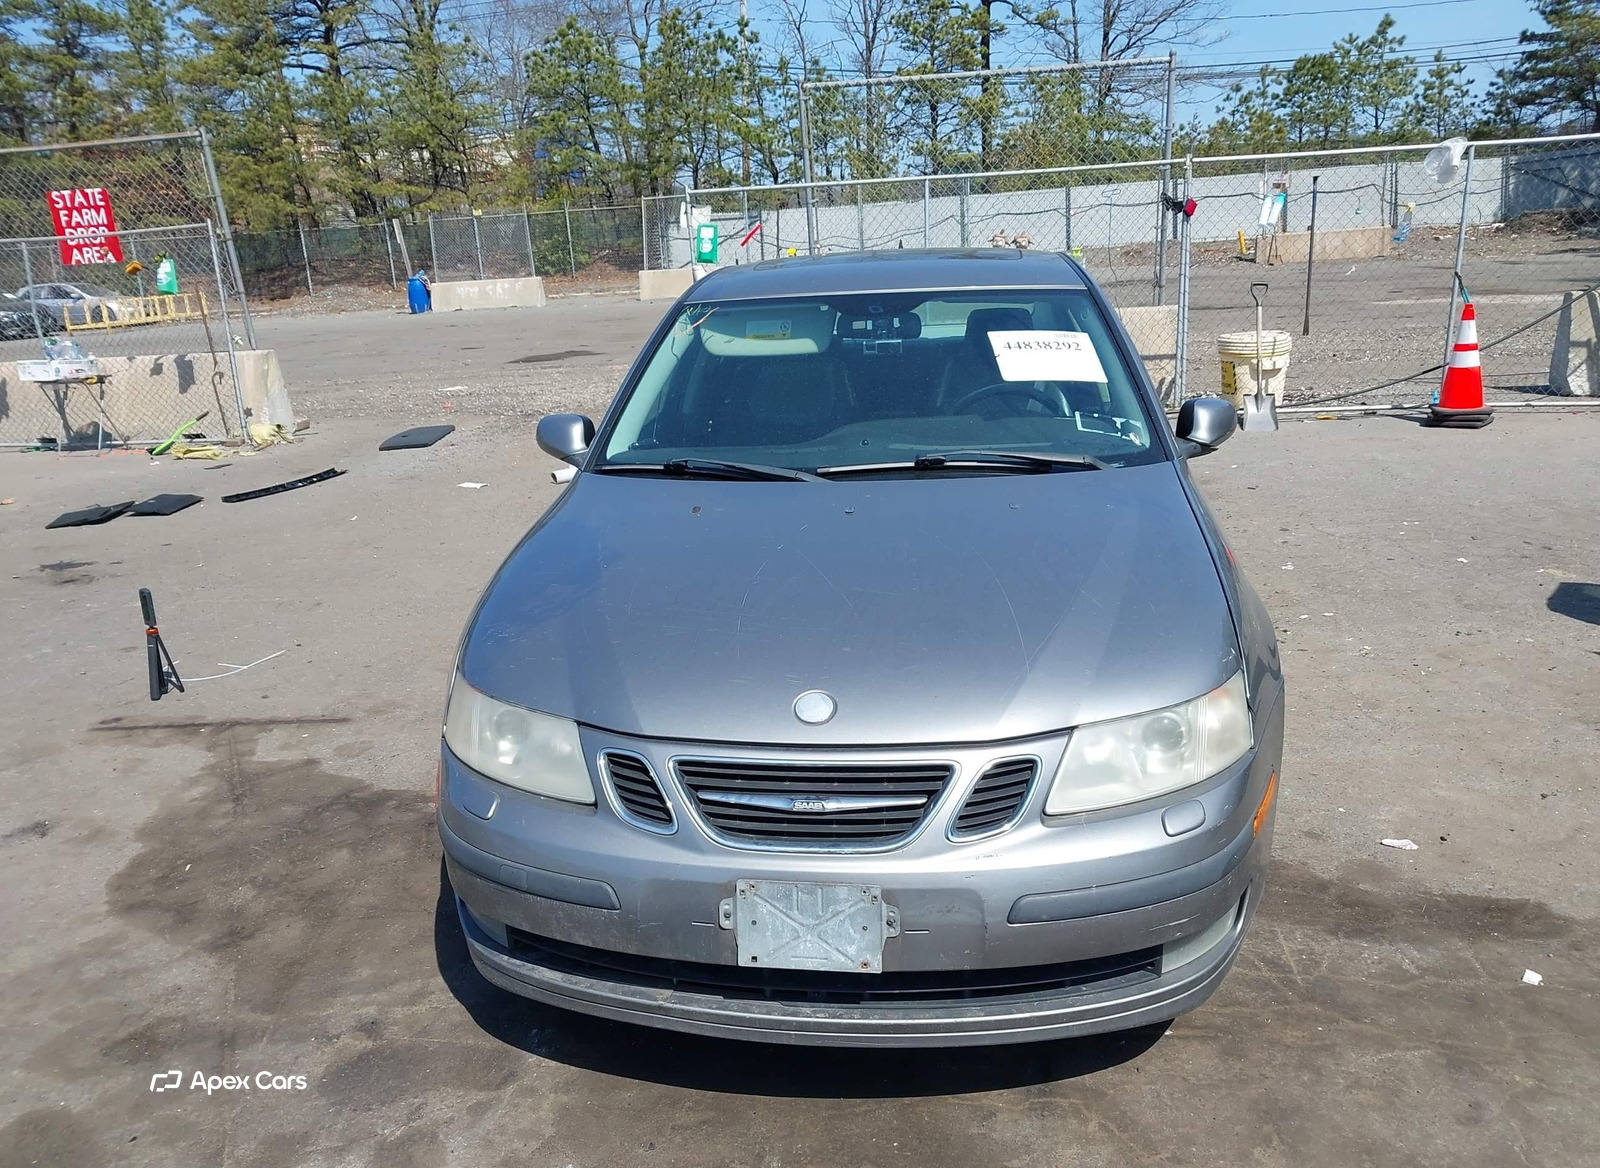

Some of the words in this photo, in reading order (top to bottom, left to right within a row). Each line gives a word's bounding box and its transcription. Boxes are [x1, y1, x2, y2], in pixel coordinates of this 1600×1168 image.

[51, 188, 106, 209] STATE
[59, 207, 108, 228] FARM
[64, 226, 109, 246] DROP
[71, 246, 117, 265] AREA
[1003, 340, 1082, 351] 44838292
[794, 801, 823, 809] SAAB
